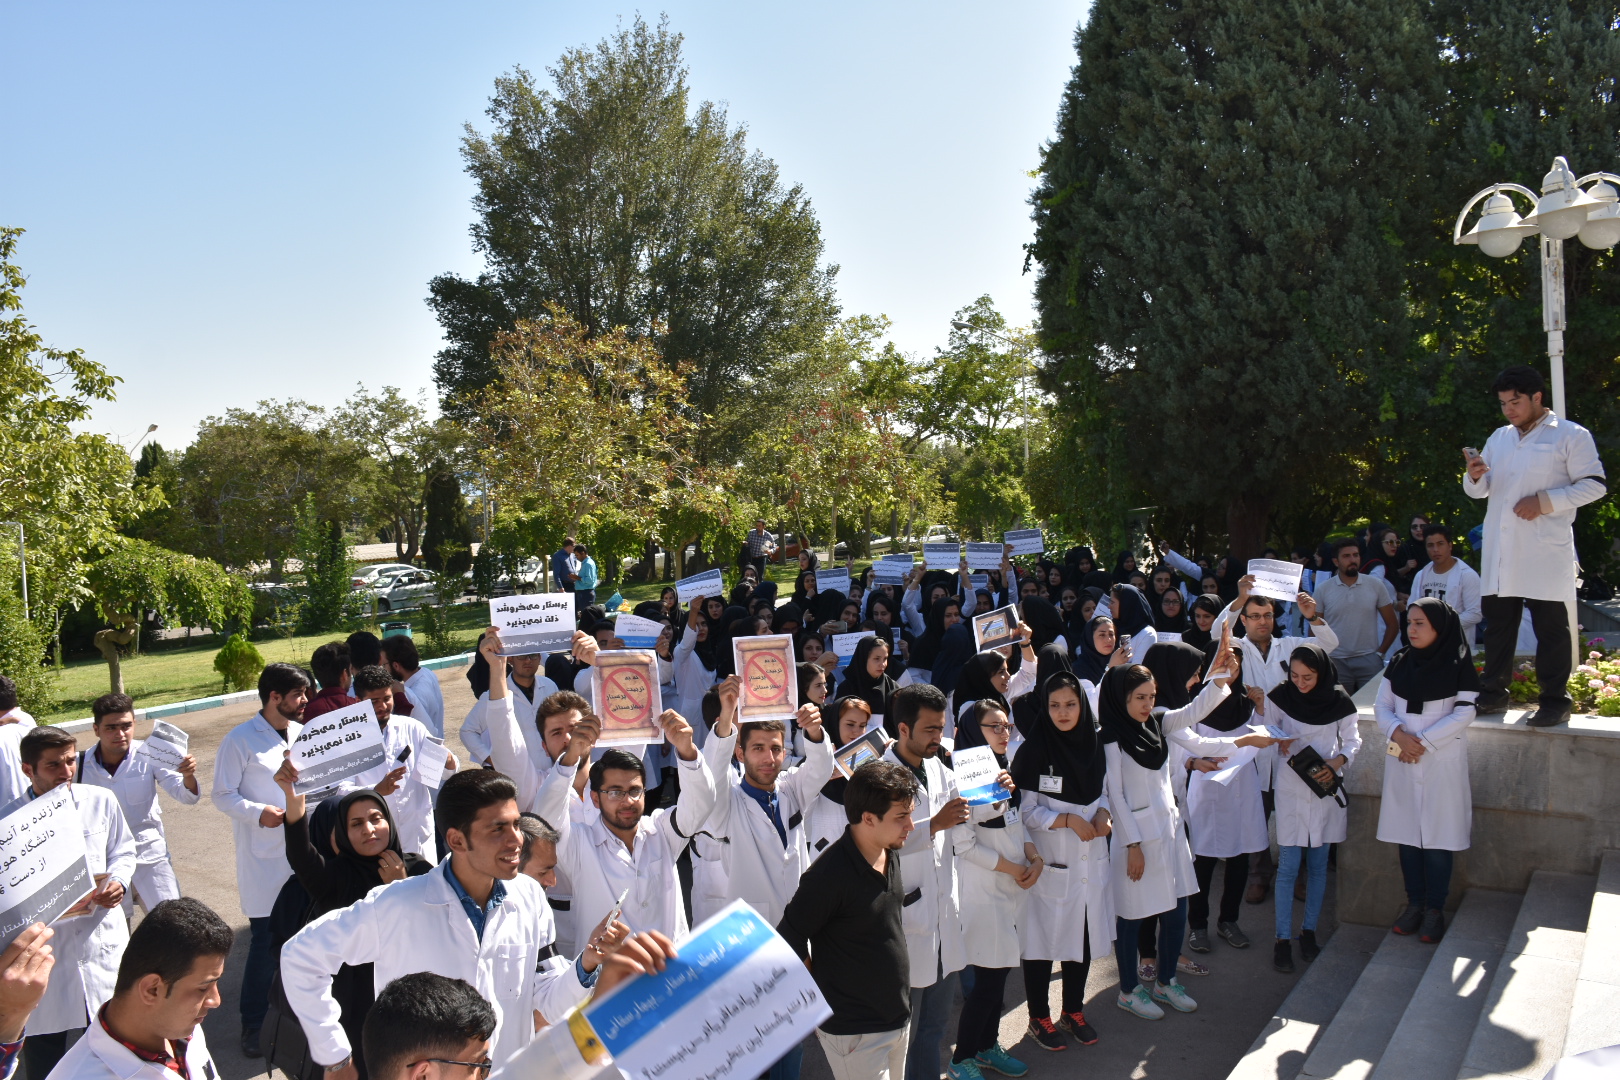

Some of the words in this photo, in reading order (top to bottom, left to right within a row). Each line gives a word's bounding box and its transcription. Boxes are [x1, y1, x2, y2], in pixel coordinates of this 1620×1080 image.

[541, 601, 568, 611] پرستار
[544, 614, 559, 623] ذلت
[339, 712, 368, 730] پرستار
[344, 730, 362, 743] ذلت
[32, 807, 53, 824] زنده
[20, 823, 31, 832] به
[20, 828, 55, 857] دانشگاه
[39, 857, 47, 872] از
[9, 866, 36, 888] دست
